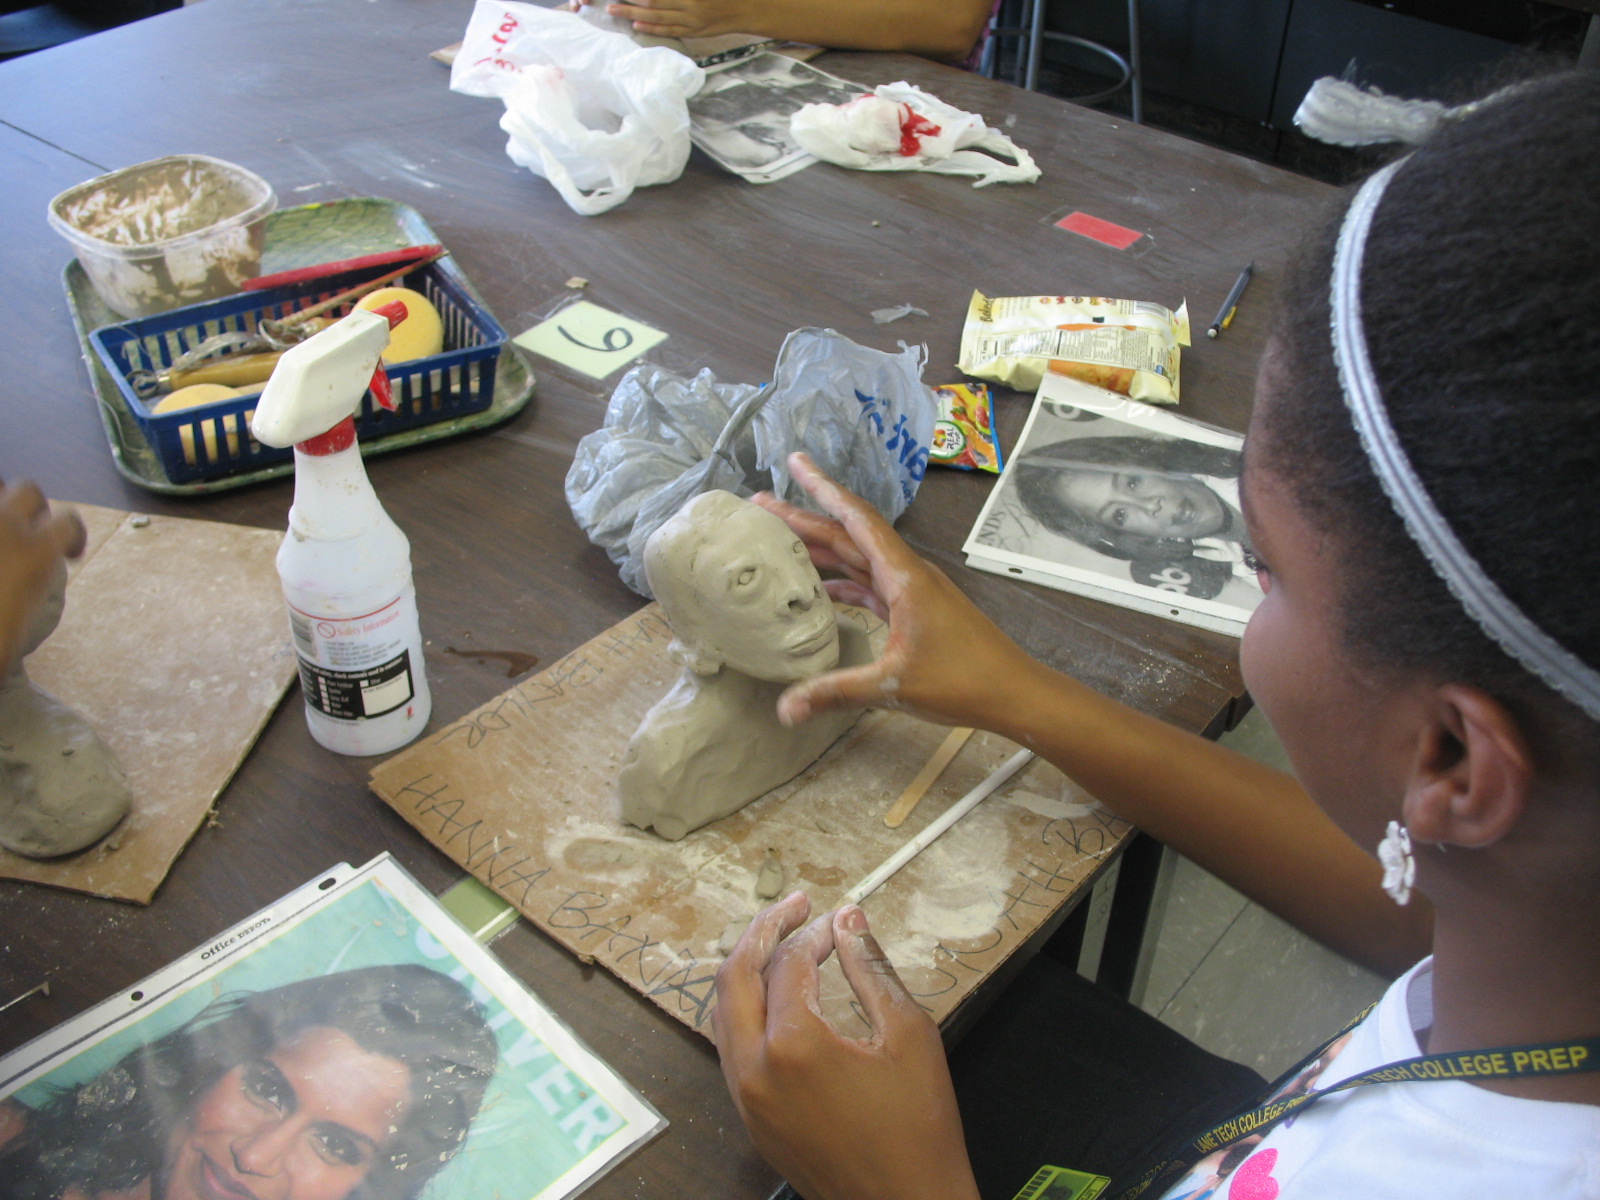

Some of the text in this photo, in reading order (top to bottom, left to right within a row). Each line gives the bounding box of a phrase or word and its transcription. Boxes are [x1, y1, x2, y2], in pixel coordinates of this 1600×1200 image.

[946, 427, 955, 450] REAL
[201, 937, 236, 960] Office
[1366, 1066, 1412, 1086] TECH
[1411, 1052, 1510, 1080] COLLEGE
[1513, 1045, 1589, 1073] PREP
[1192, 1132, 1219, 1154] LANE
[1213, 1119, 1240, 1144] TECH
[1238, 1101, 1285, 1134] COLLEGE
